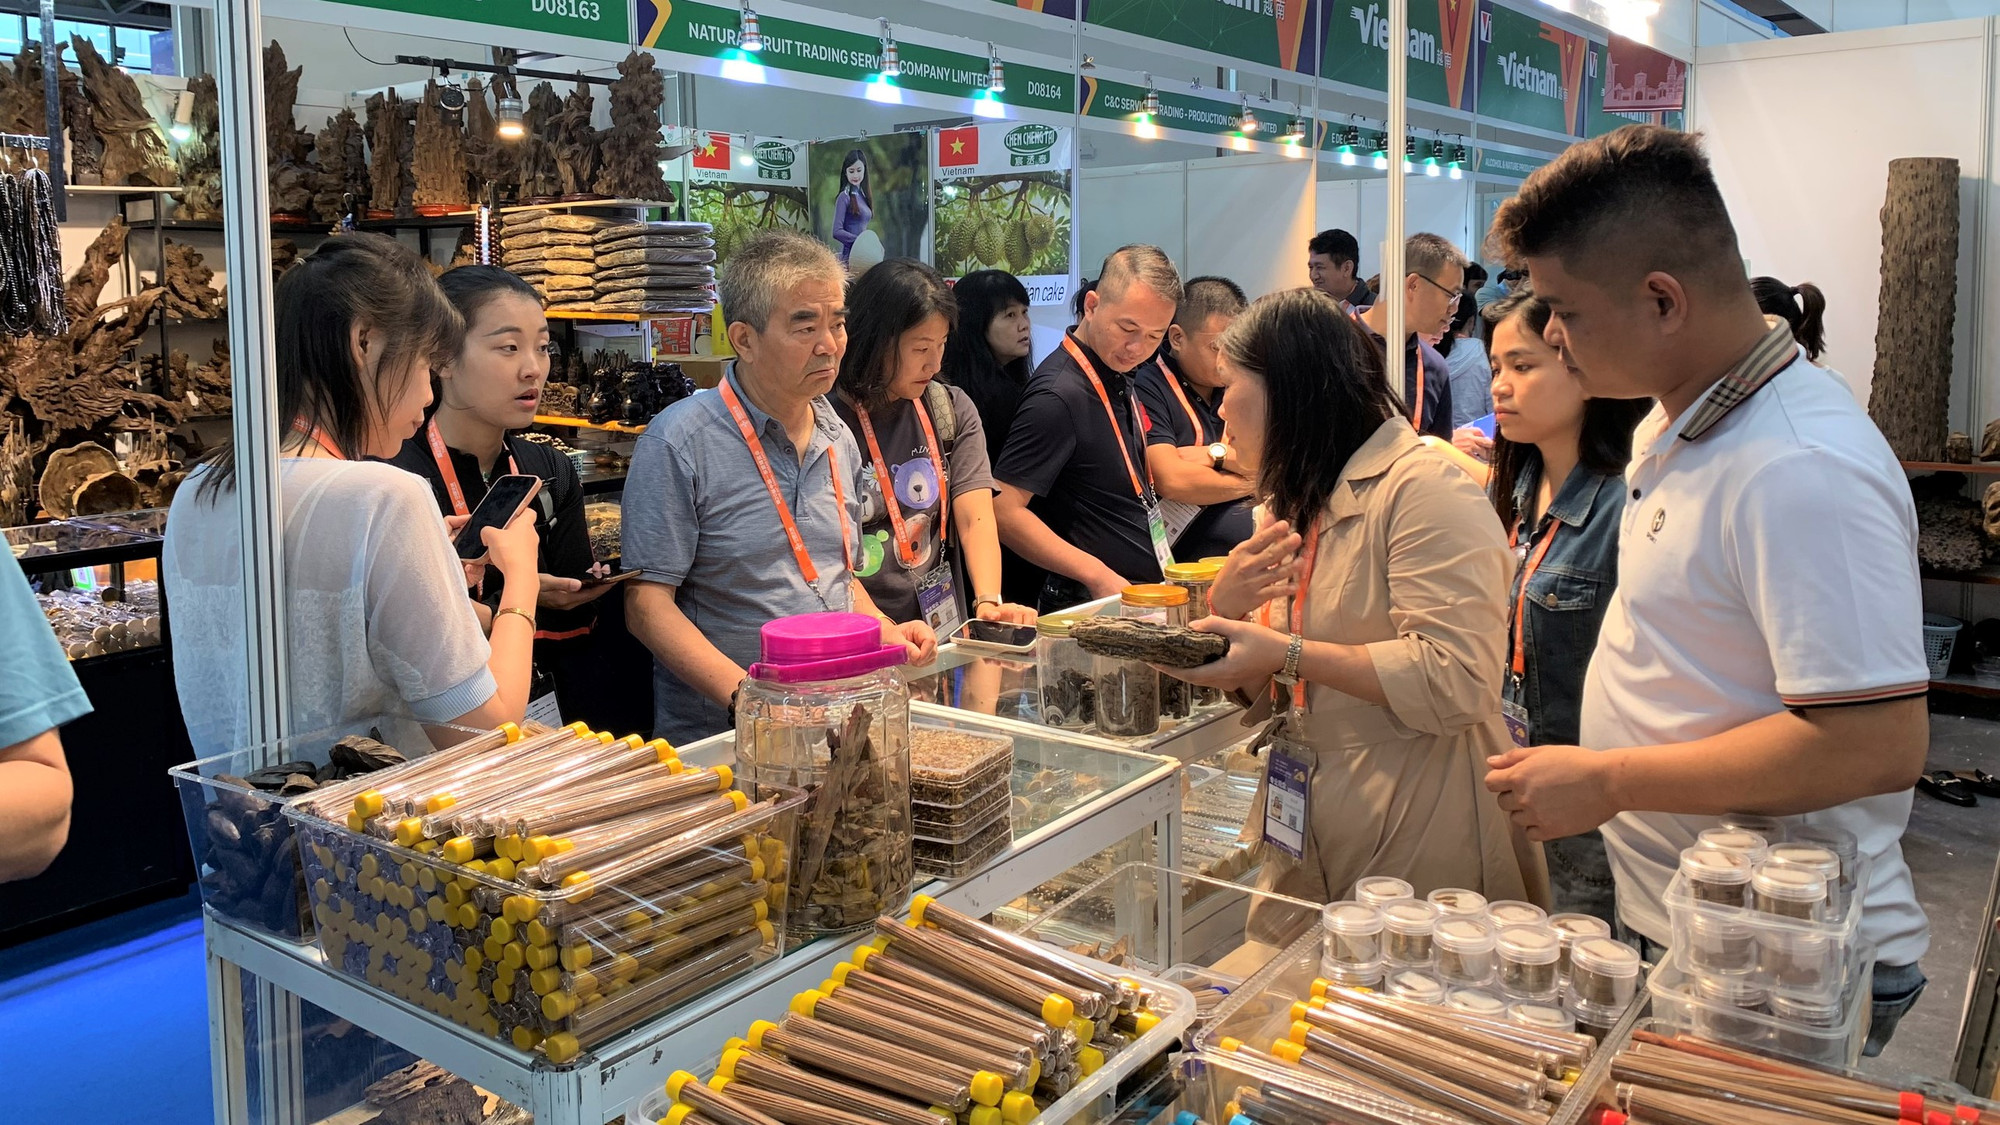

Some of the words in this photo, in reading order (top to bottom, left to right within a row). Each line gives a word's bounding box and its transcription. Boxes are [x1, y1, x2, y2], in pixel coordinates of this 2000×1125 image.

[532, 0, 601, 21] D08163
[760, 34, 794, 55] RUIT
[794, 41, 849, 66] TRADING
[899, 60, 951, 81] COMPANY
[952, 68, 989, 87] LIMITED
[1028, 81, 1062, 99] D08164
[1497, 51, 1558, 99] Vietnam
[1104, 95, 1120, 108] C&C
[1188, 109, 1228, 125] PRODUCTION
[1005, 133, 1022, 147] CHEN
[696, 169, 728, 180] Vietnam
[942, 167, 975, 177] Vietnam
[1041, 281, 1065, 302] cake
